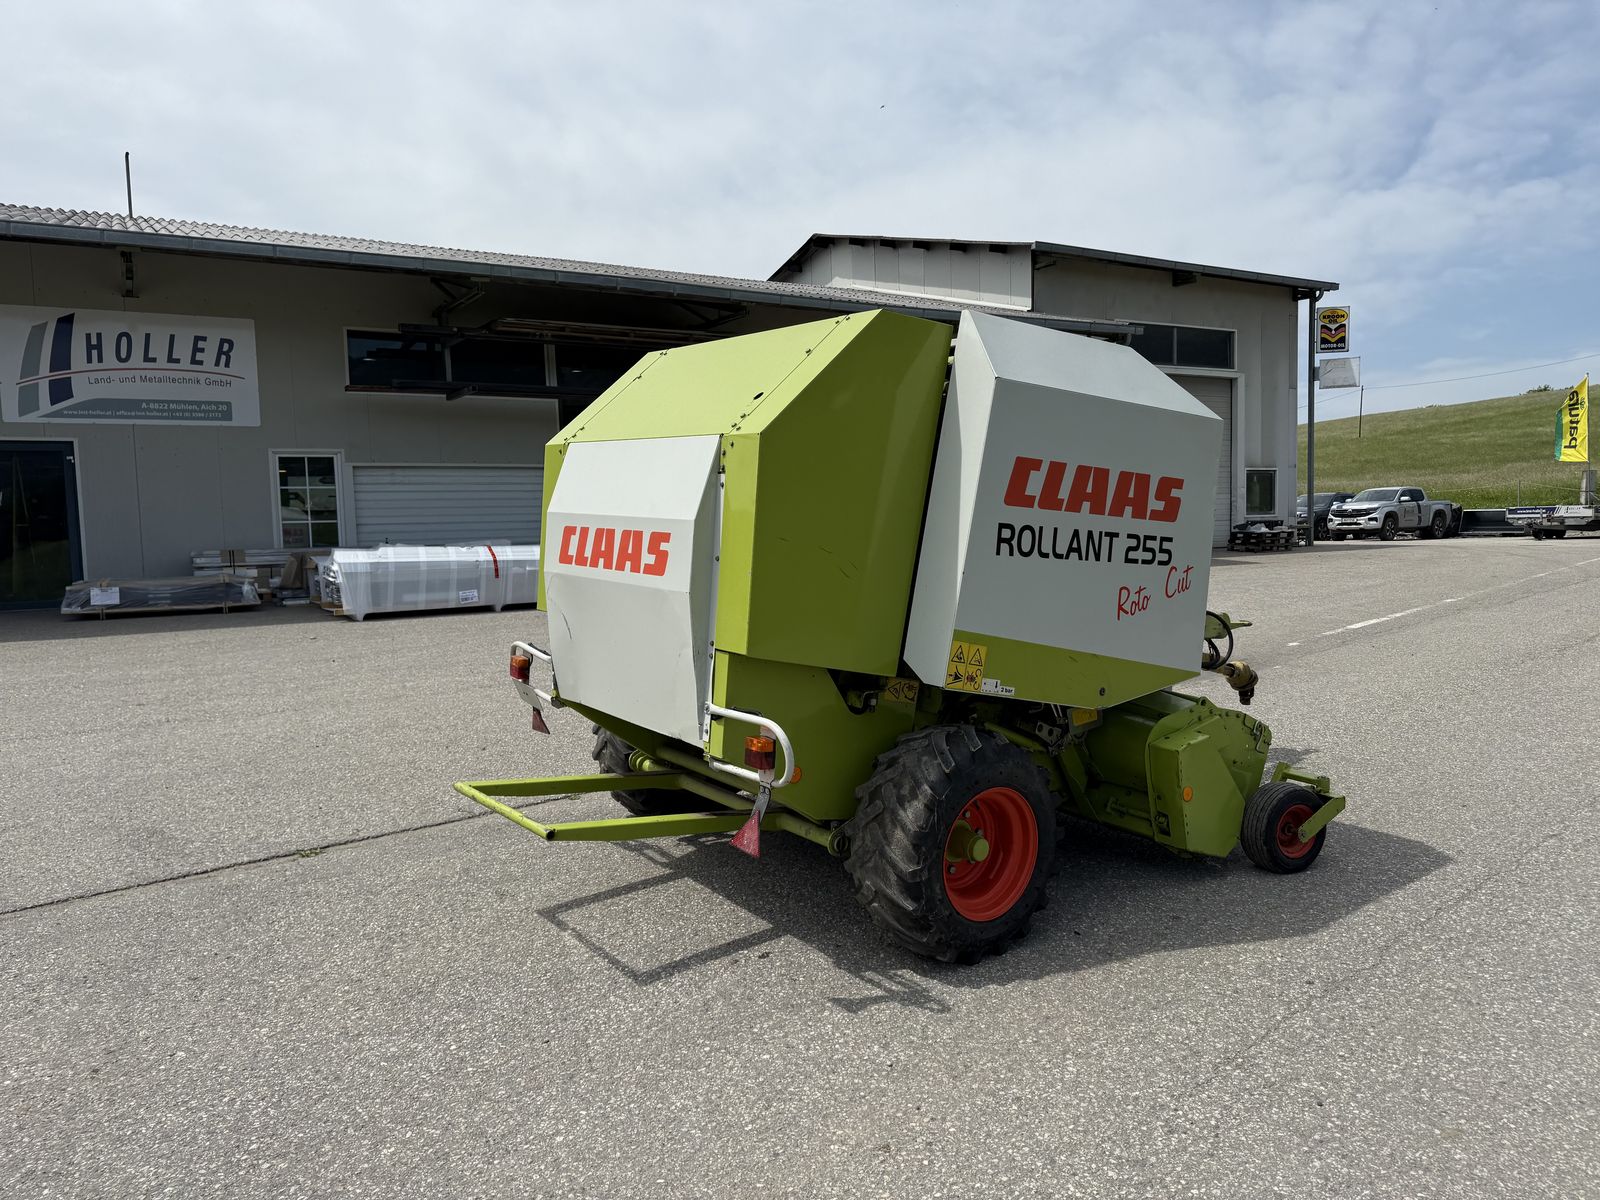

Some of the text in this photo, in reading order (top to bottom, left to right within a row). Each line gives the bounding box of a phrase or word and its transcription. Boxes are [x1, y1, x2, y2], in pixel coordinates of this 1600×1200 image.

[85, 331, 235, 369] HOLLER
[87, 375, 233, 388] Land- und Metalltechnik GmbH
[141, 402, 168, 410] A-8822
[201, 403, 217, 411] Aich
[1003, 456, 1185, 523] CLAAS
[558, 525, 672, 577] CLAAS
[995, 522, 1174, 566] ROLLANT 255
[1117, 564, 1194, 621] Roto Cut
